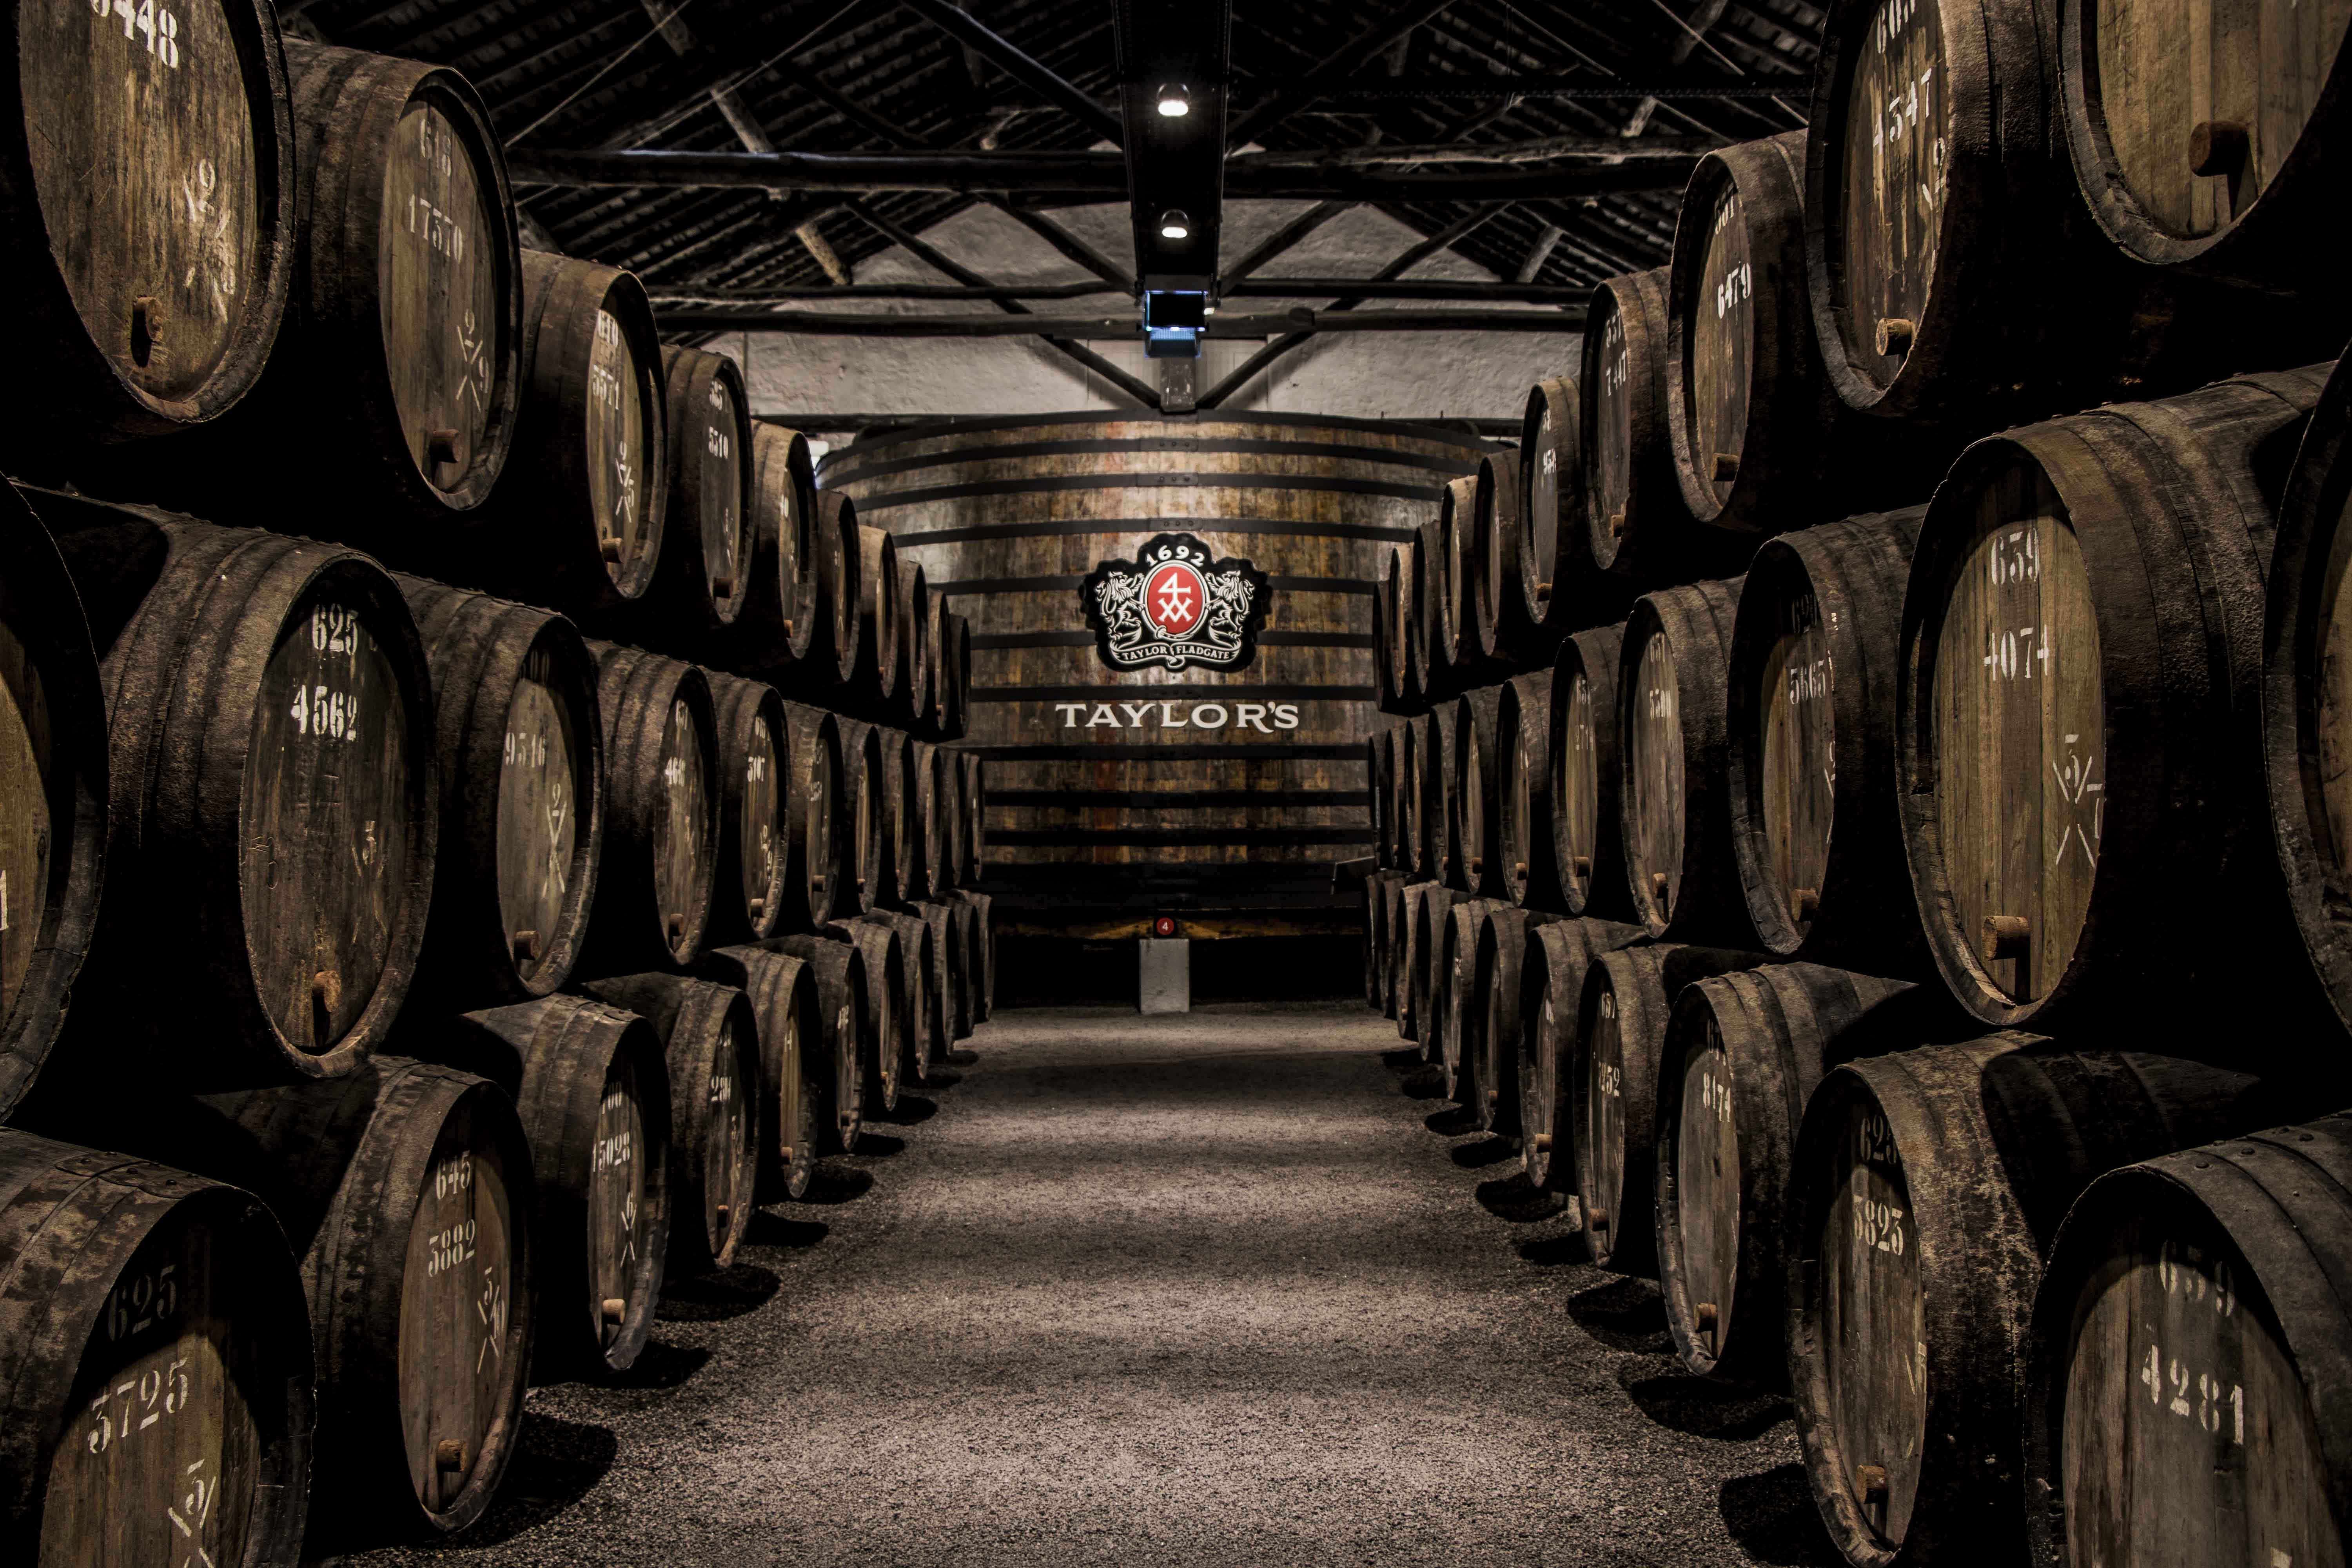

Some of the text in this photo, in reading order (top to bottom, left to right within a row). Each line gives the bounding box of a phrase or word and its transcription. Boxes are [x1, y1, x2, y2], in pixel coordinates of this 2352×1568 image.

[1146, 545, 1205, 567] 1692
[1122, 646, 1230, 660] TAYLOR FLADGATE
[1984, 624, 2049, 681] 4074
[1055, 701, 1299, 733] TAYLOR'S
[1162, 922, 1169, 931] 4
[436, 1149, 470, 1200] 645
